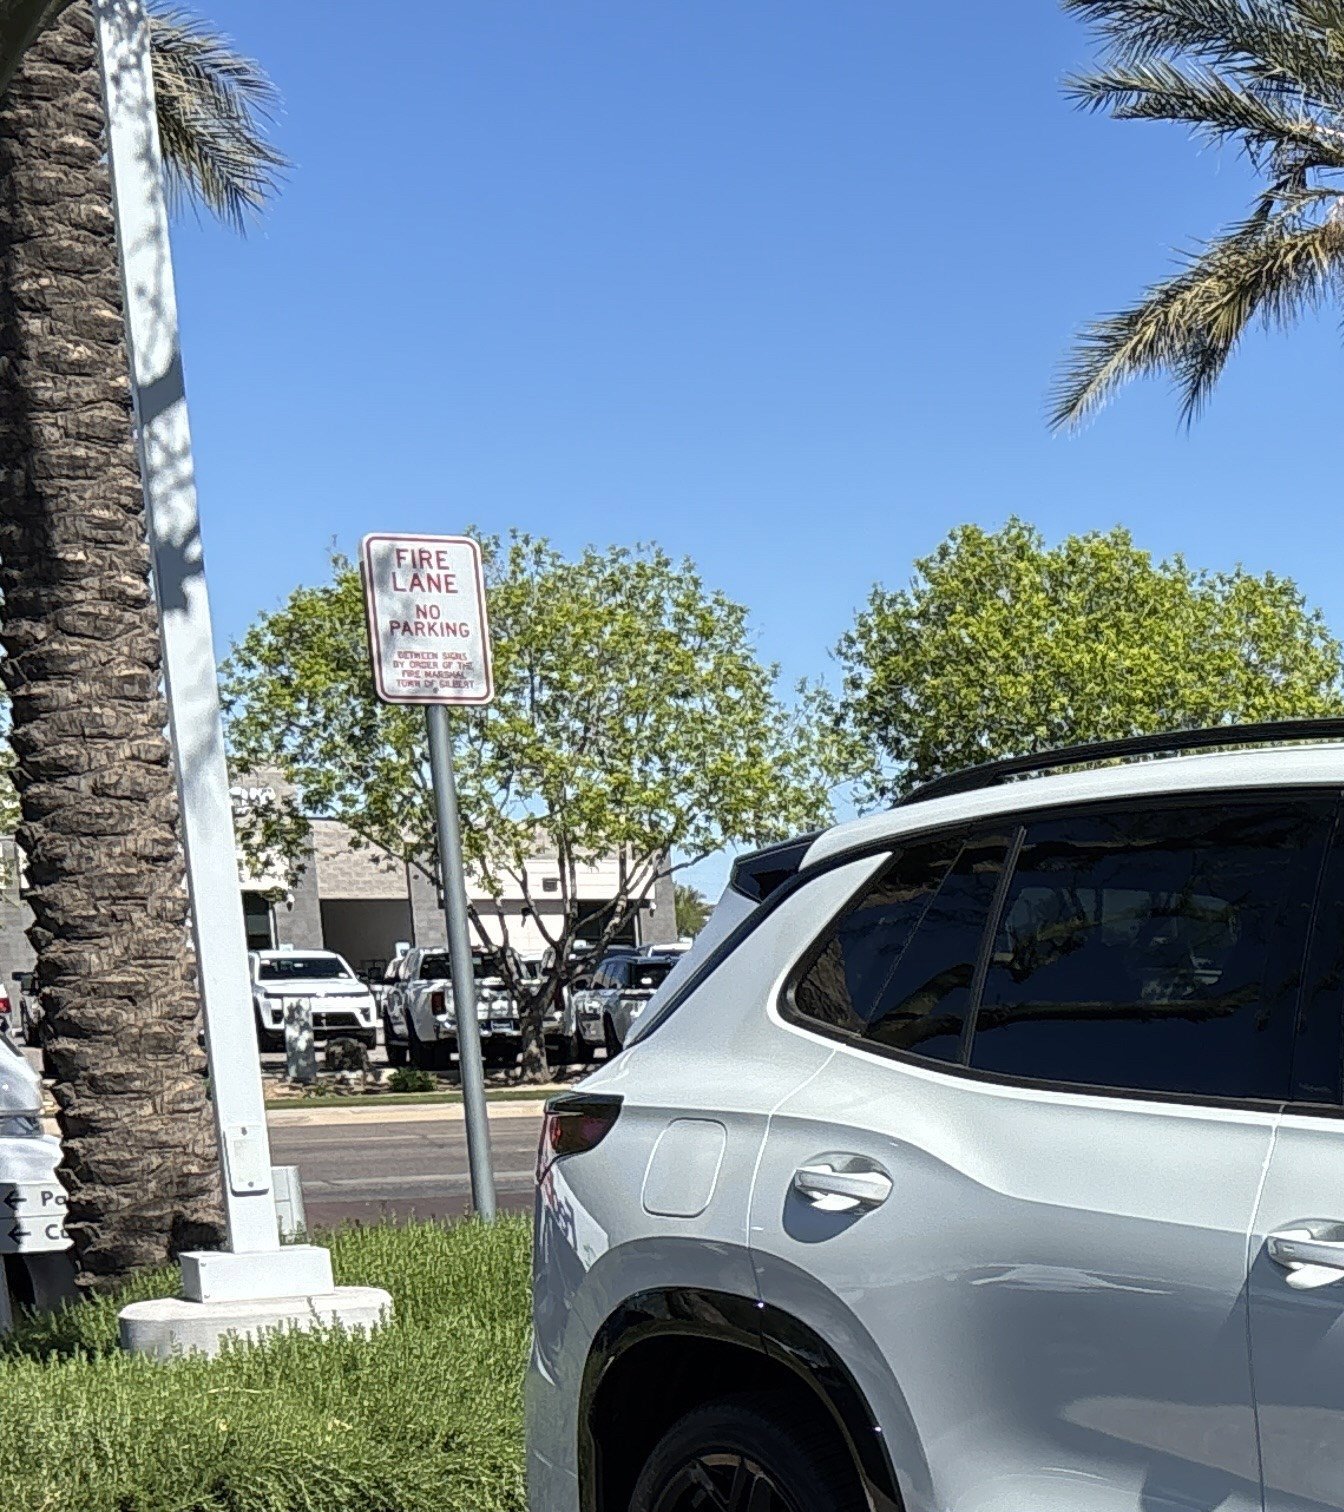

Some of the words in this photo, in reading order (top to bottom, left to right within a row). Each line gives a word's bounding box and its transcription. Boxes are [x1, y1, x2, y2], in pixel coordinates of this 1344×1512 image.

[395, 547, 450, 570] FIRE
[391, 571, 459, 594] LANE
[415, 603, 441, 620] NO
[388, 619, 470, 638] PARKING
